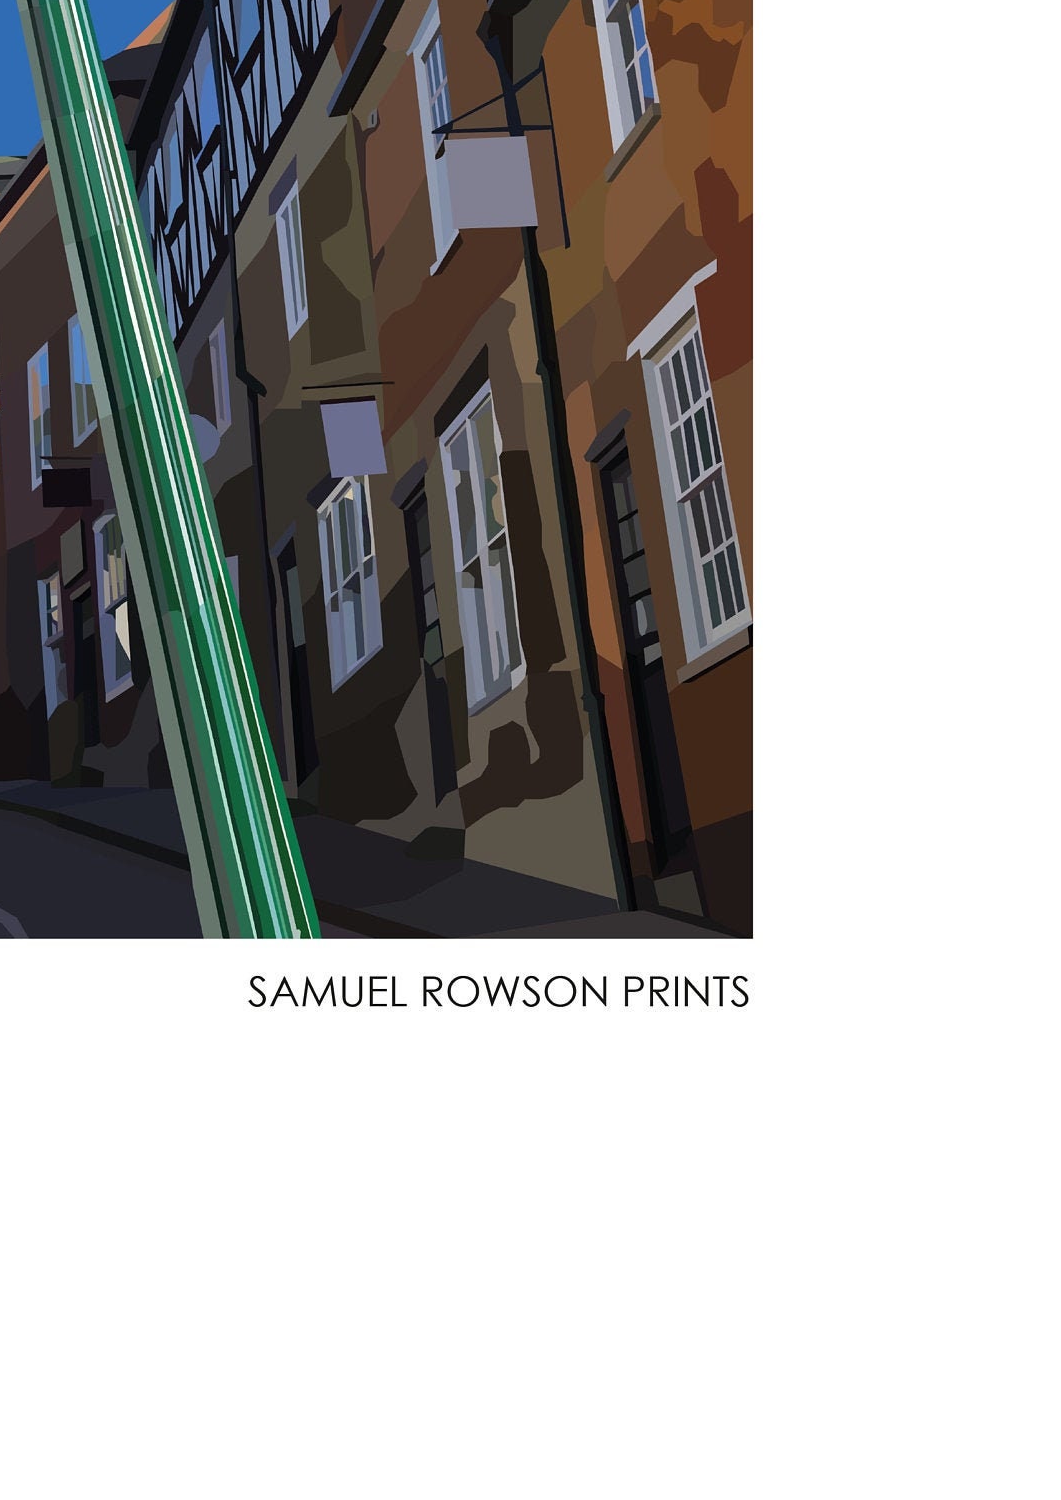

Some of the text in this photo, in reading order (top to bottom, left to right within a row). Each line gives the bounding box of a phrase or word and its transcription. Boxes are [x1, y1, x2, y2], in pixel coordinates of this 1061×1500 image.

[248, 975, 749, 1008] SAMUEL ROWSON PRINTS
